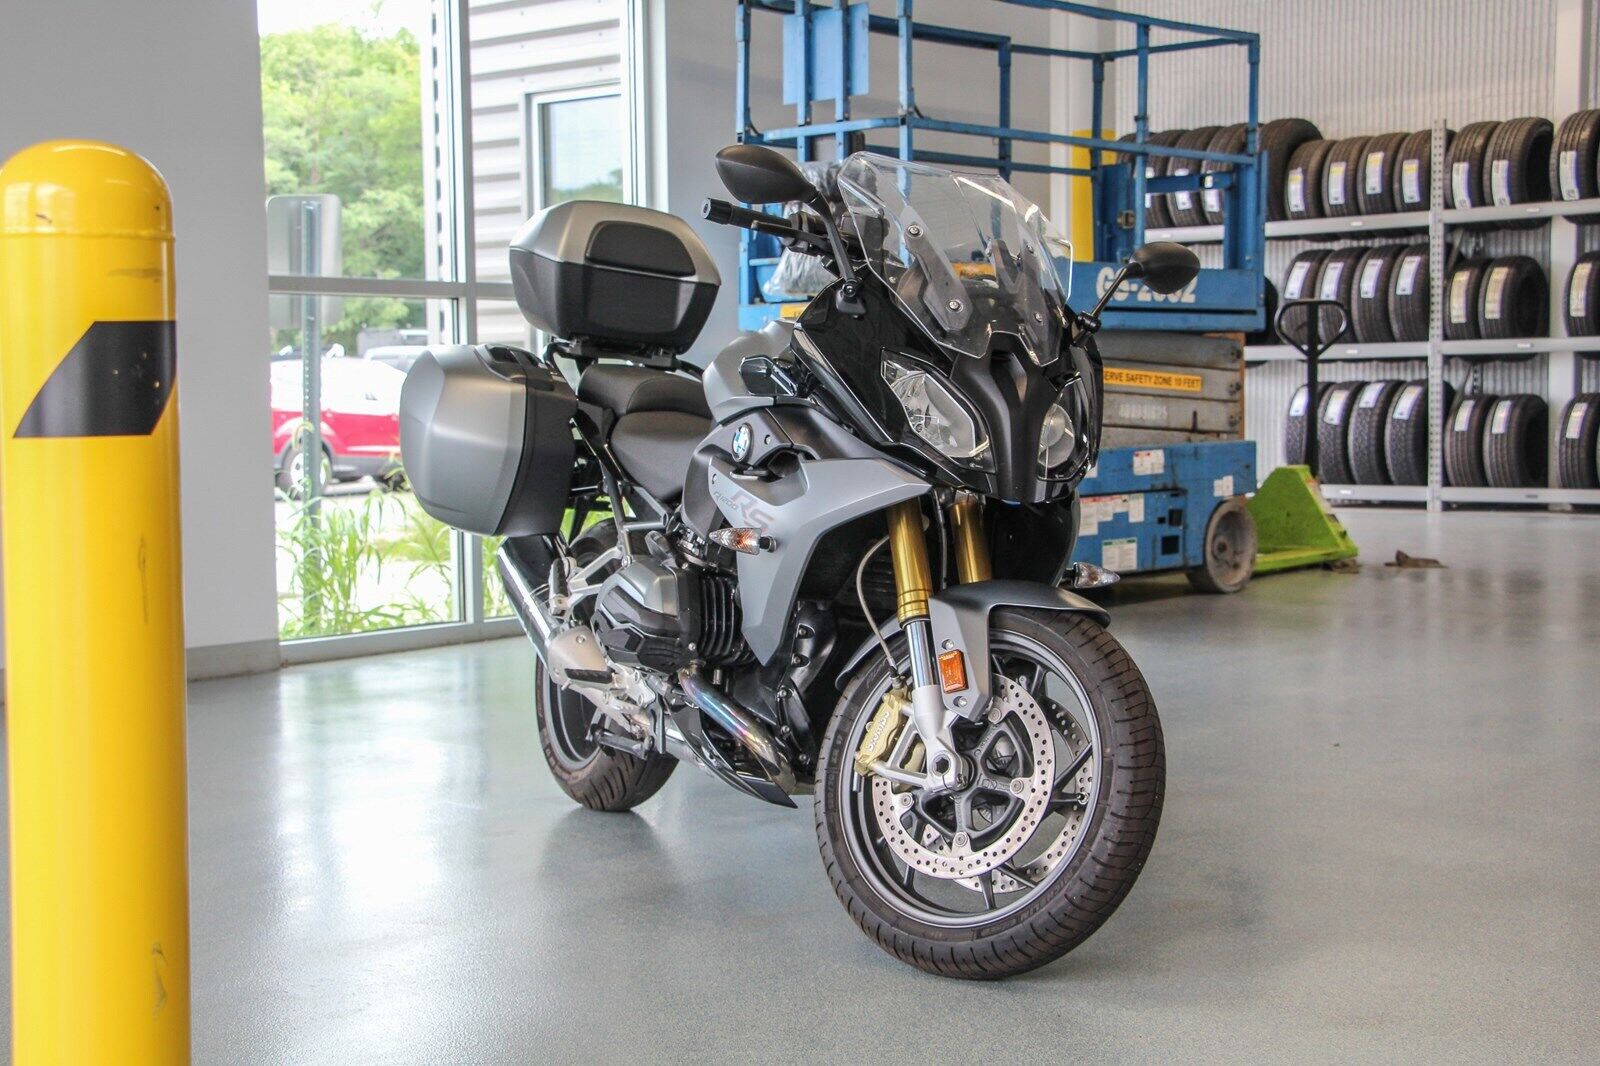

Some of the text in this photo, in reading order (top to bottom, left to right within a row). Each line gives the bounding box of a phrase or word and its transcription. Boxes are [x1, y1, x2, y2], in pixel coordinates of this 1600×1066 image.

[1103, 370, 1124, 382] ERVE
[1126, 372, 1152, 385] SAFETY
[1153, 375, 1172, 386] ZONE
[1183, 377, 1201, 389] FEET
